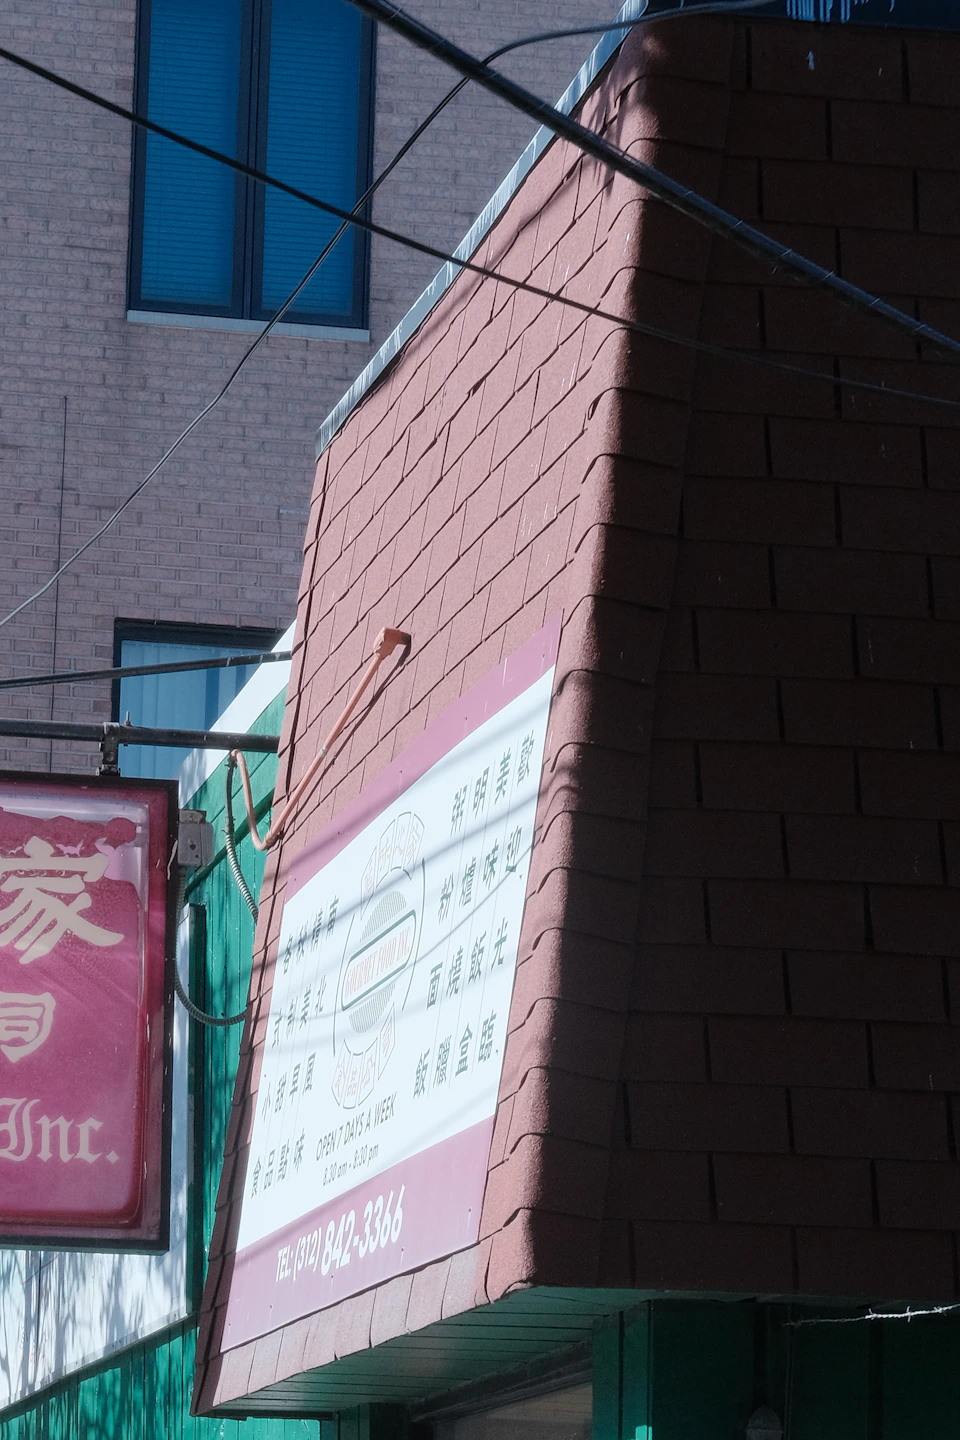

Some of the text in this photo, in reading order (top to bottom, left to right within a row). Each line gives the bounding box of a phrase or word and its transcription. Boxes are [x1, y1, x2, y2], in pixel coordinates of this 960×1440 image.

[344, 952, 377, 997] GOURMET
[378, 939, 396, 975] FOOD
[412, 785, 467, 1100] 粥粉面飯
[455, 747, 511, 1077] 美味飯盒
[477, 730, 535, 1063] 歡迎光臨
[251, 934, 294, 1199] 各式小食
[316, 1092, 397, 1161] OPEN 7 DAYS A WEEK
[276, 1184, 405, 1282] TEL: (312) 842-3366
[337, 1164, 348, 1178] am
[352, 1144, 368, 1170] 8:30
[367, 1143, 379, 1167] pm
